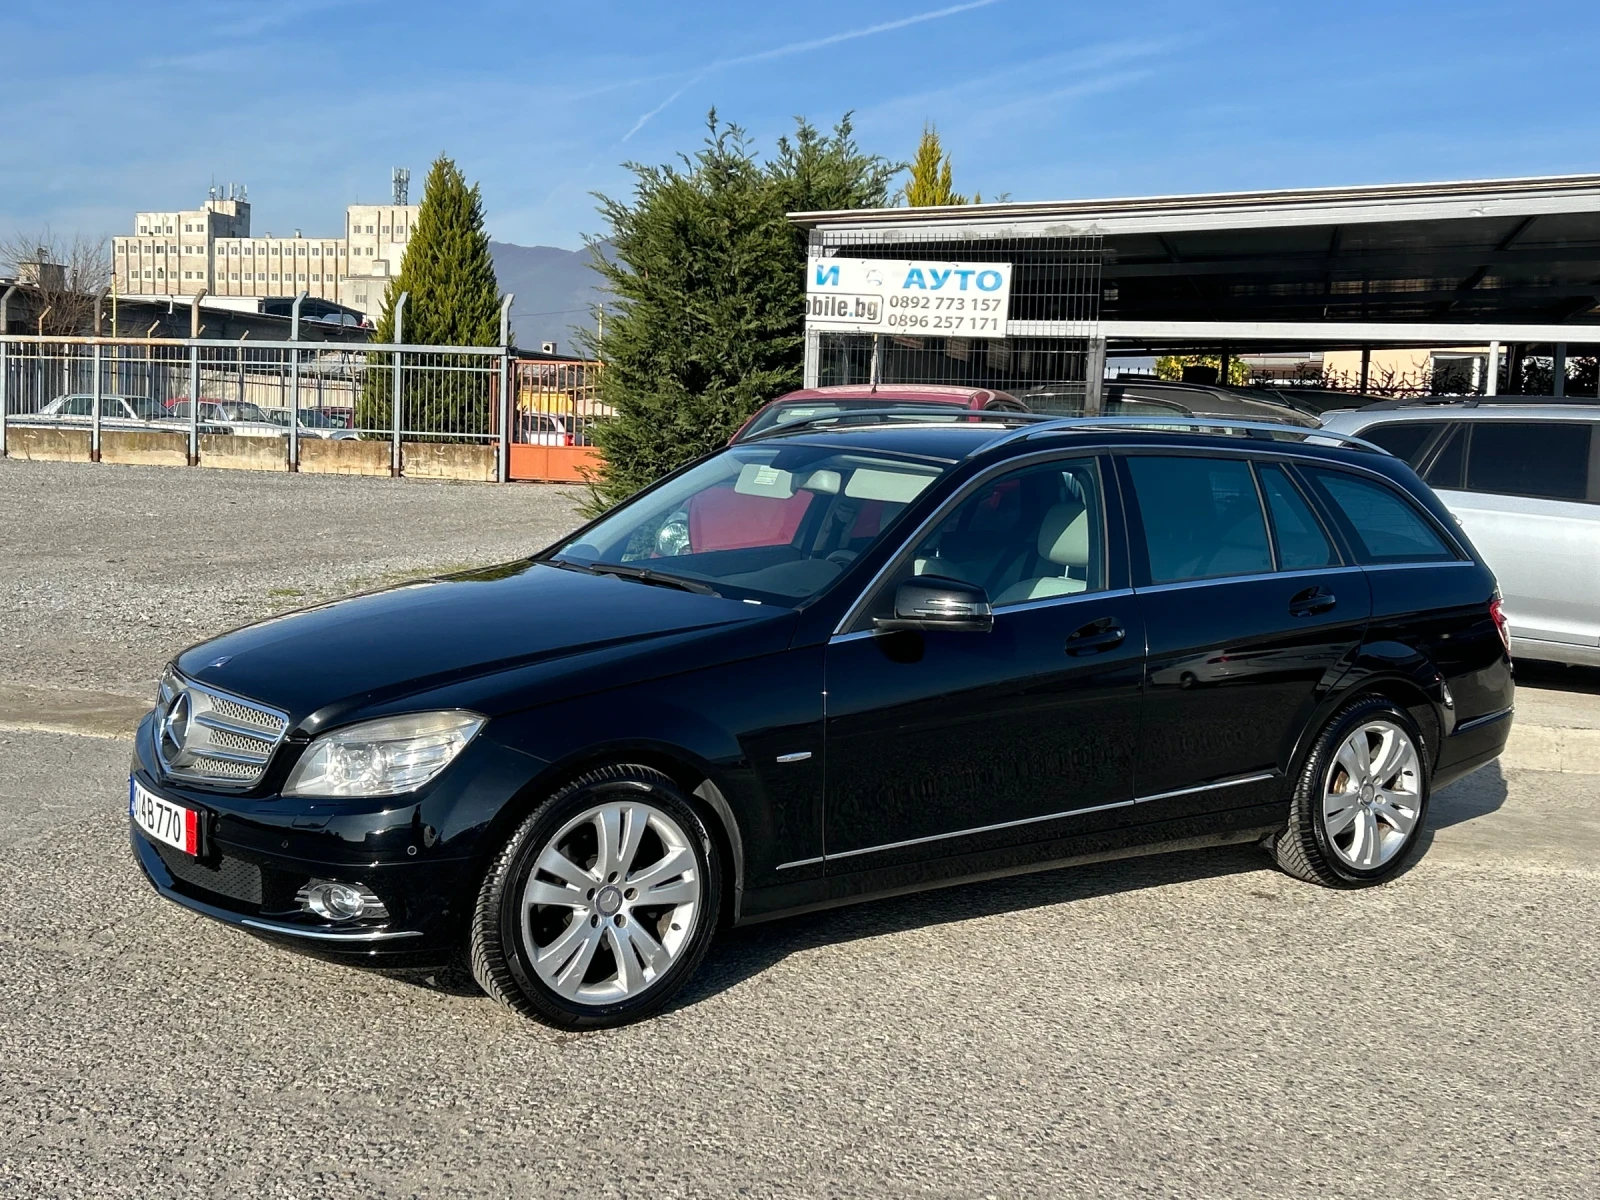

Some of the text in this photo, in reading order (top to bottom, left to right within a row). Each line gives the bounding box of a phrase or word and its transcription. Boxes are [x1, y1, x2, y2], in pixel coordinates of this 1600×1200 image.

[816, 264, 1003, 291] И АУТО
[890, 295, 1002, 312] 0892 773 157
[888, 314, 998, 330] 0896 257 171
